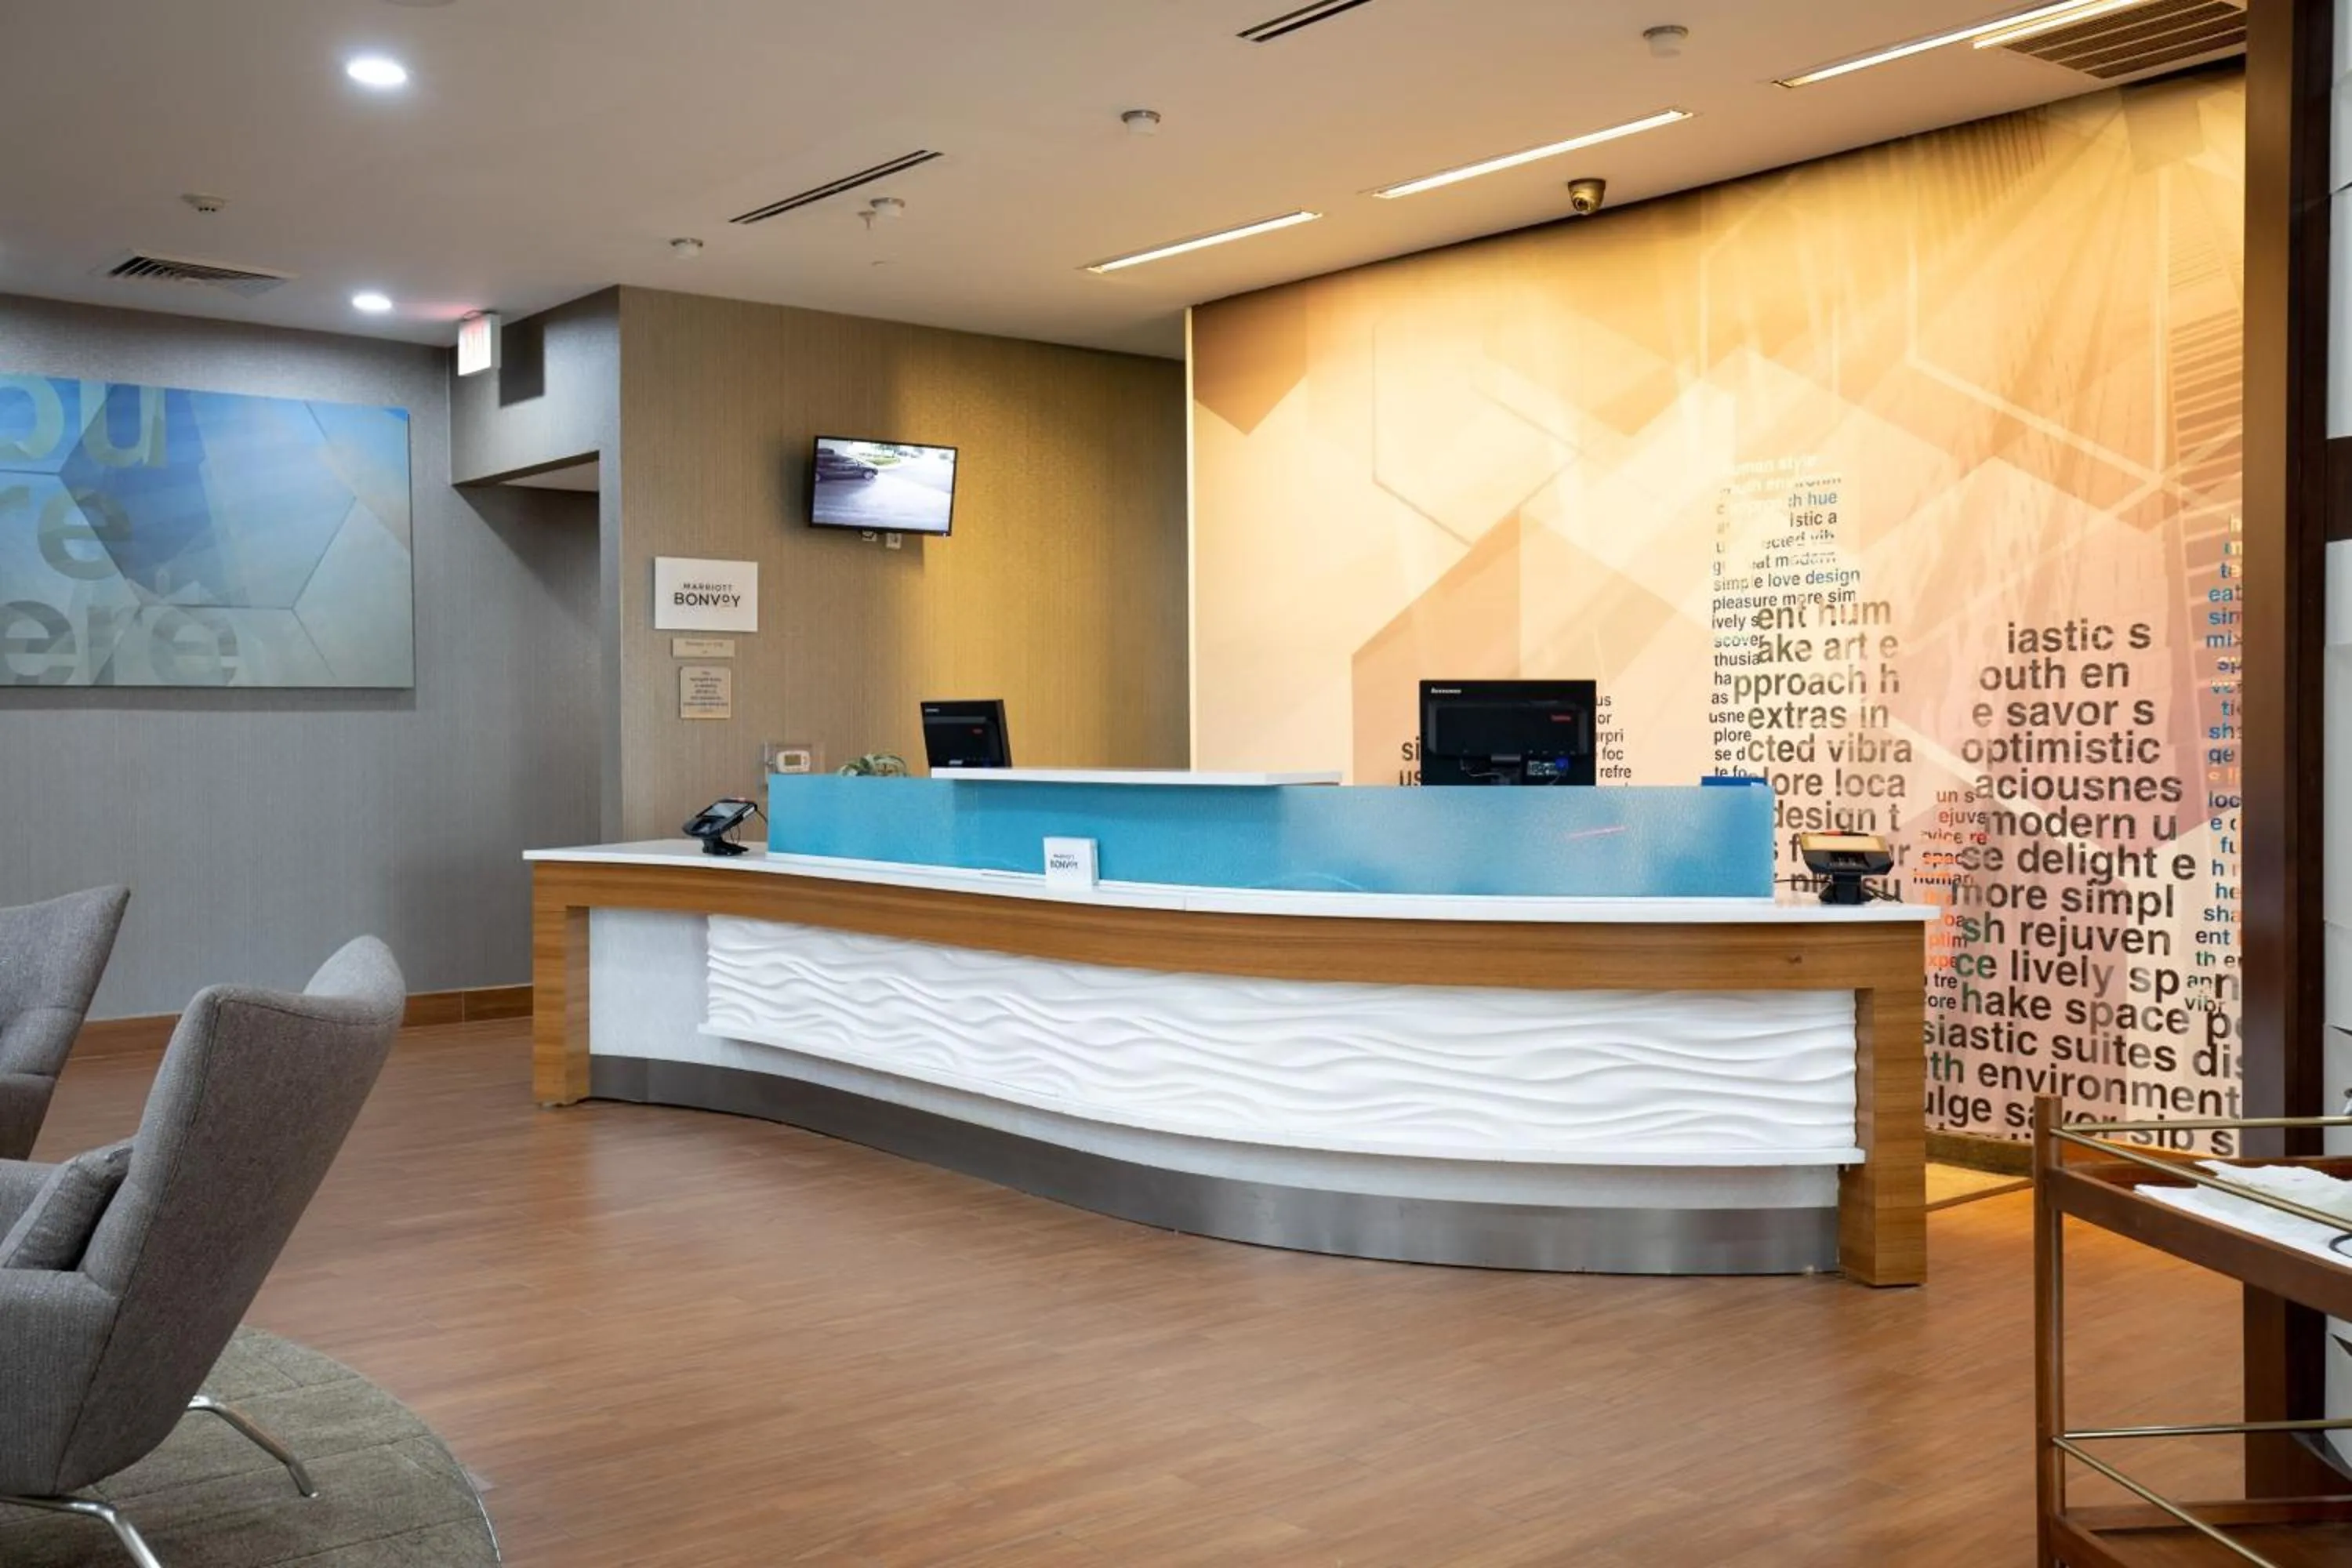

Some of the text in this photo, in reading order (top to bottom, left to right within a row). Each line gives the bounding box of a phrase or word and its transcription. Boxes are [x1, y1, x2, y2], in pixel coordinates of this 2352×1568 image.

[683, 582, 733, 592] MARRIOTT
[1768, 572, 1801, 587] love
[1806, 568, 1860, 587] design
[673, 592, 741, 608] BONVOY
[1712, 594, 1778, 614] pleasure
[1759, 631, 1899, 663] ake art e
[2008, 618, 2151, 654] iastic s
[1715, 663, 1900, 704] ha pproach h
[1980, 657, 2129, 691] outh en
[1711, 692, 1729, 705] as
[1972, 699, 2155, 728] e savor s
[1709, 710, 1745, 724] usne
[1748, 699, 1889, 730] extras in
[1714, 727, 1752, 746] plore
[1748, 731, 1912, 764] cted vibra
[1962, 729, 2161, 772] optimistic
[1602, 746, 1624, 761] foc
[1715, 746, 1746, 761] se d
[1600, 764, 1632, 779] refre
[1835, 768, 1907, 798] loca
[1975, 768, 2183, 803] aciousnes
[1936, 789, 1958, 803] un
[1889, 803, 1901, 832] t
[1938, 808, 1987, 828] ejuve
[1984, 805, 2178, 842] modern u
[1959, 841, 2196, 887] se delight e
[1951, 880, 2048, 910] more
[2060, 878, 2175, 925] simpl
[1962, 910, 2172, 957] sh rejuven
[2195, 930, 2231, 946] ent
[1955, 952, 1998, 979] ce
[2010, 949, 2115, 998] lively
[2129, 965, 2180, 1003] sp
[1962, 982, 2052, 1021] hake
[2065, 997, 2190, 1036] space
[2051, 1033, 2177, 1073] suites
[1978, 1063, 2241, 1121] environment
